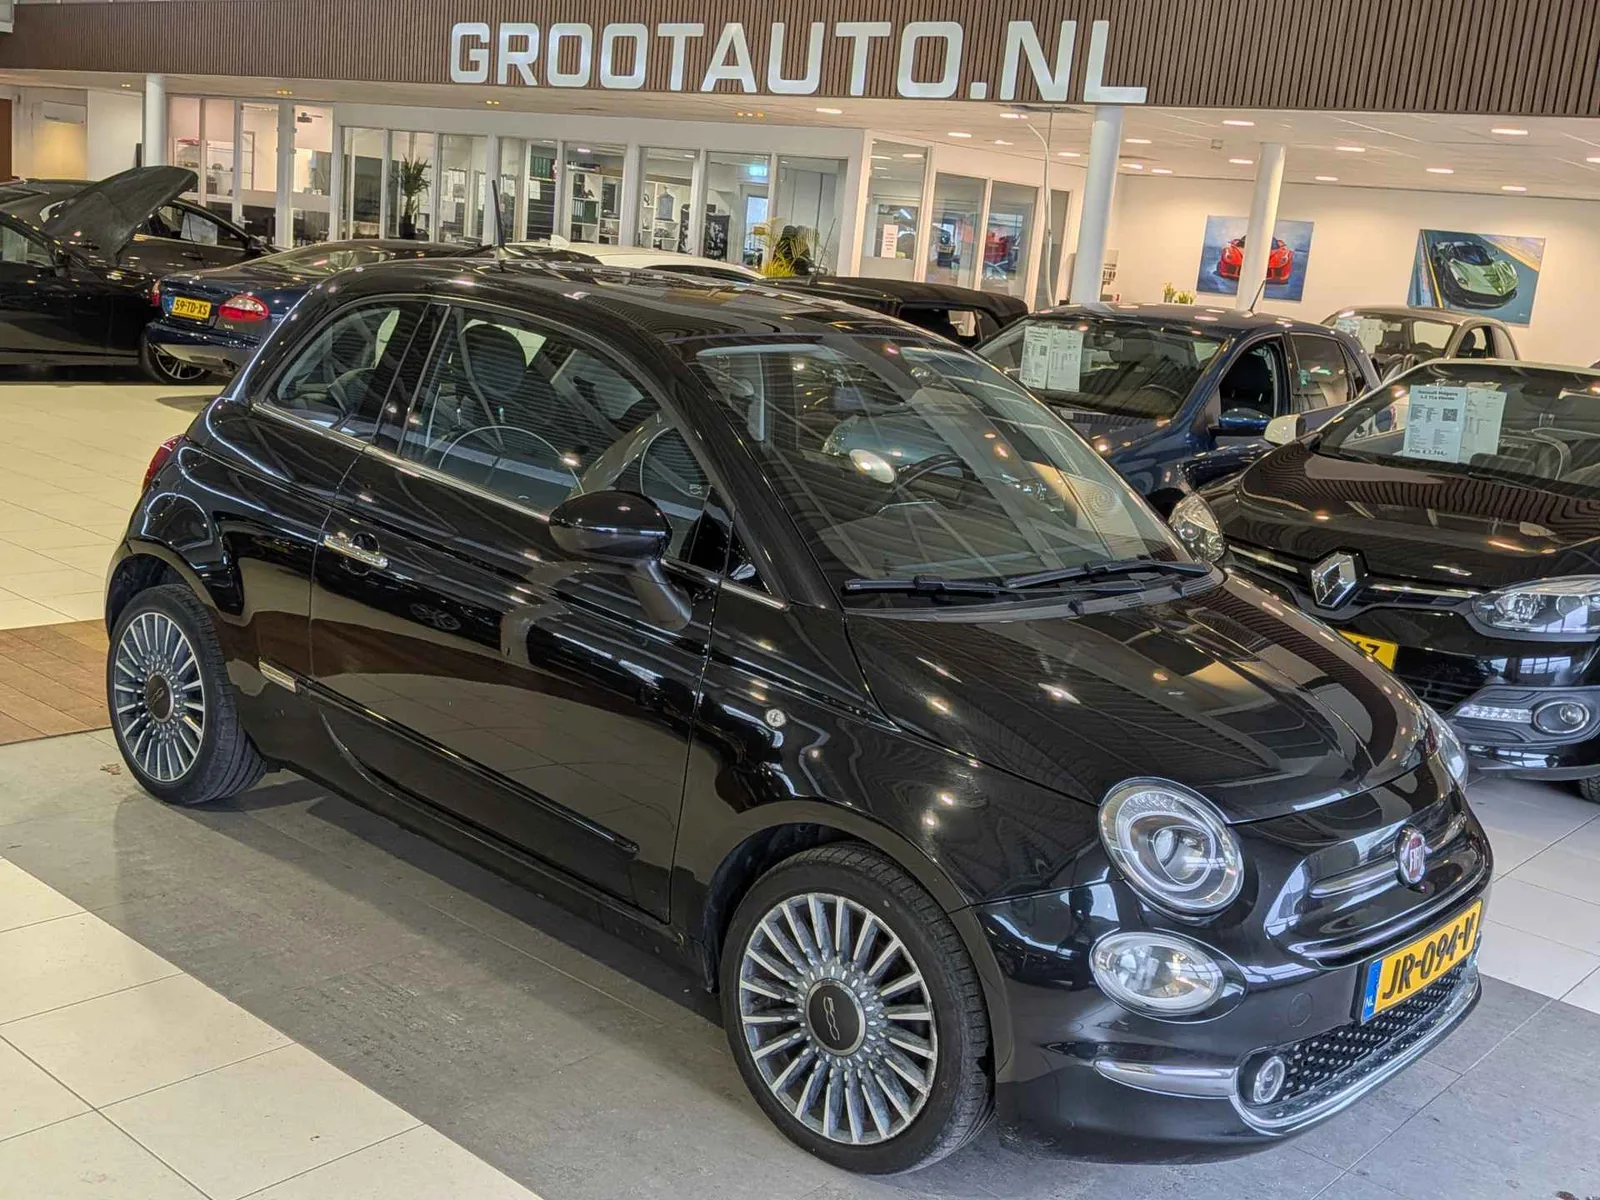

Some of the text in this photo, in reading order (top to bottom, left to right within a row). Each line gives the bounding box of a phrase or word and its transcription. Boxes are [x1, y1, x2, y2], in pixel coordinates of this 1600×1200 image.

[451, 20, 1147, 104] GROOTAUTO.NL
[175, 299, 208, 315] 59-TD-XS
[1382, 912, 1476, 999] JR-094-V
